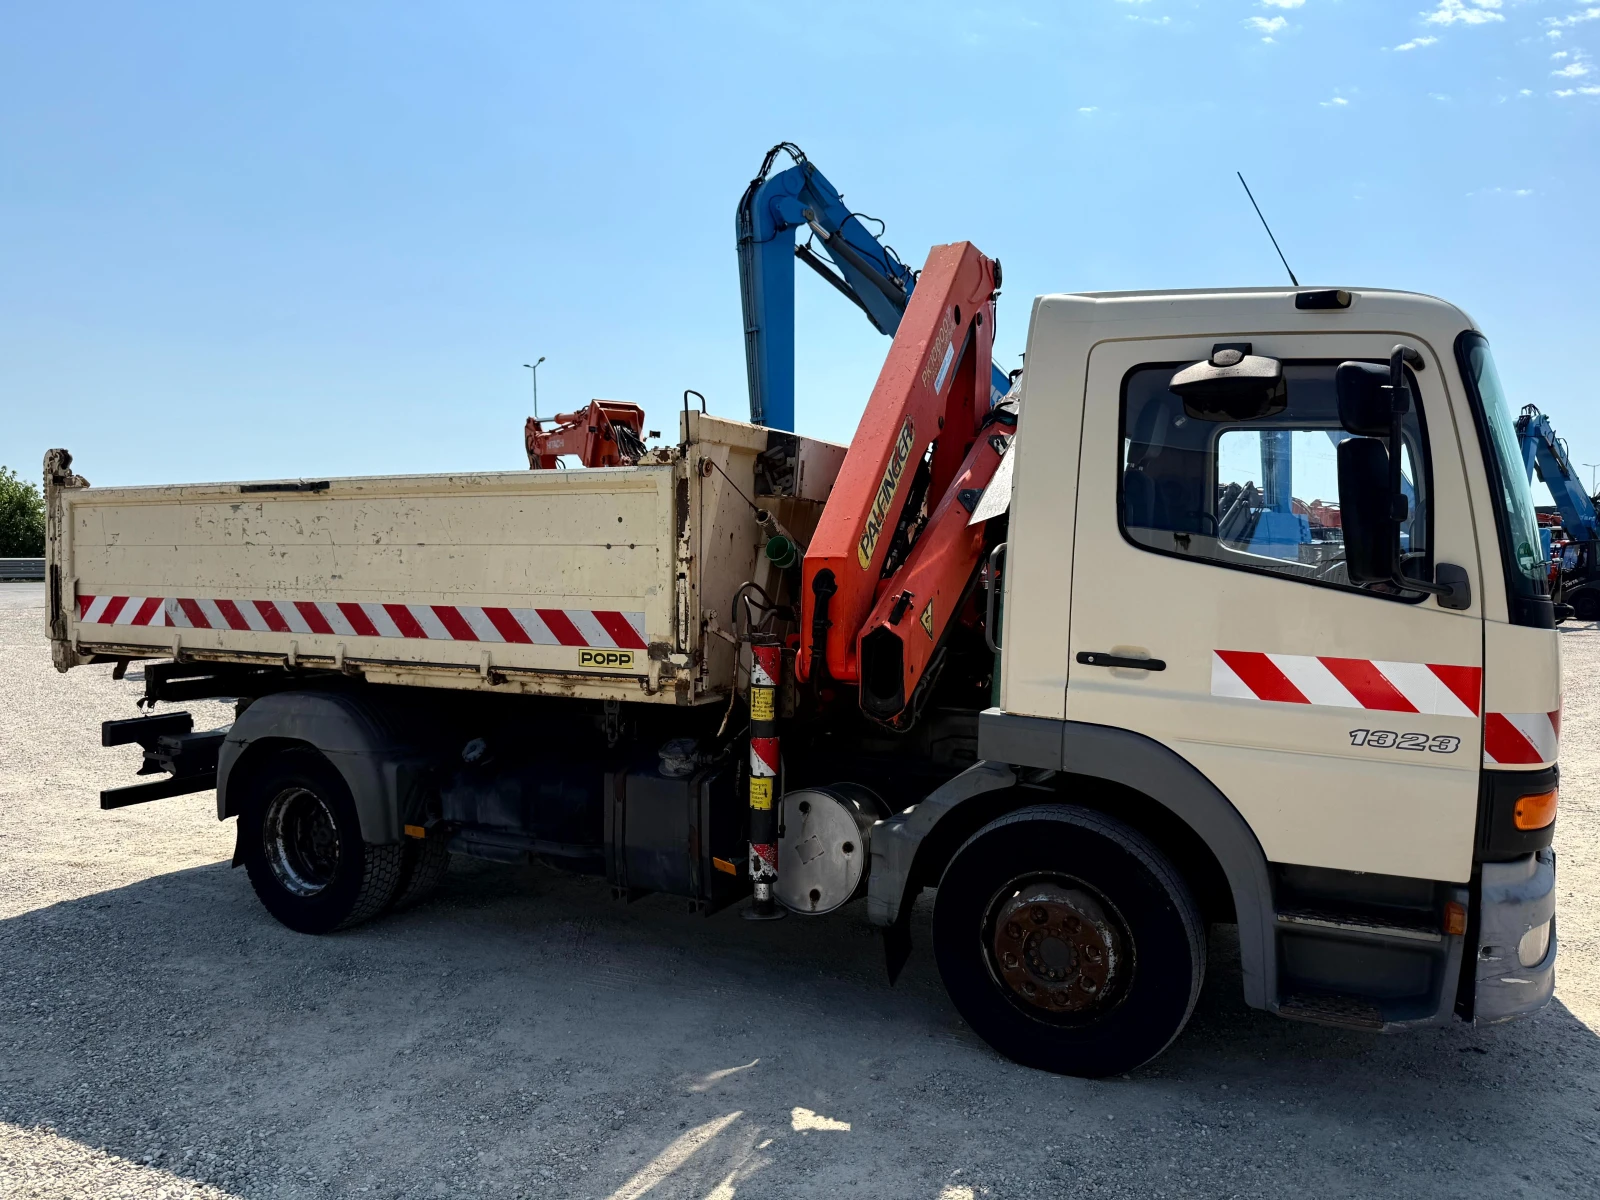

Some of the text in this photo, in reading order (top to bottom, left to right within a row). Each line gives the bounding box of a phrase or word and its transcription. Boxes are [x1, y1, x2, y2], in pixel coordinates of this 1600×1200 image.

[860, 424, 913, 560] PALFINGER
[581, 652, 631, 665] POPP
[1349, 729, 1461, 753] 1323
